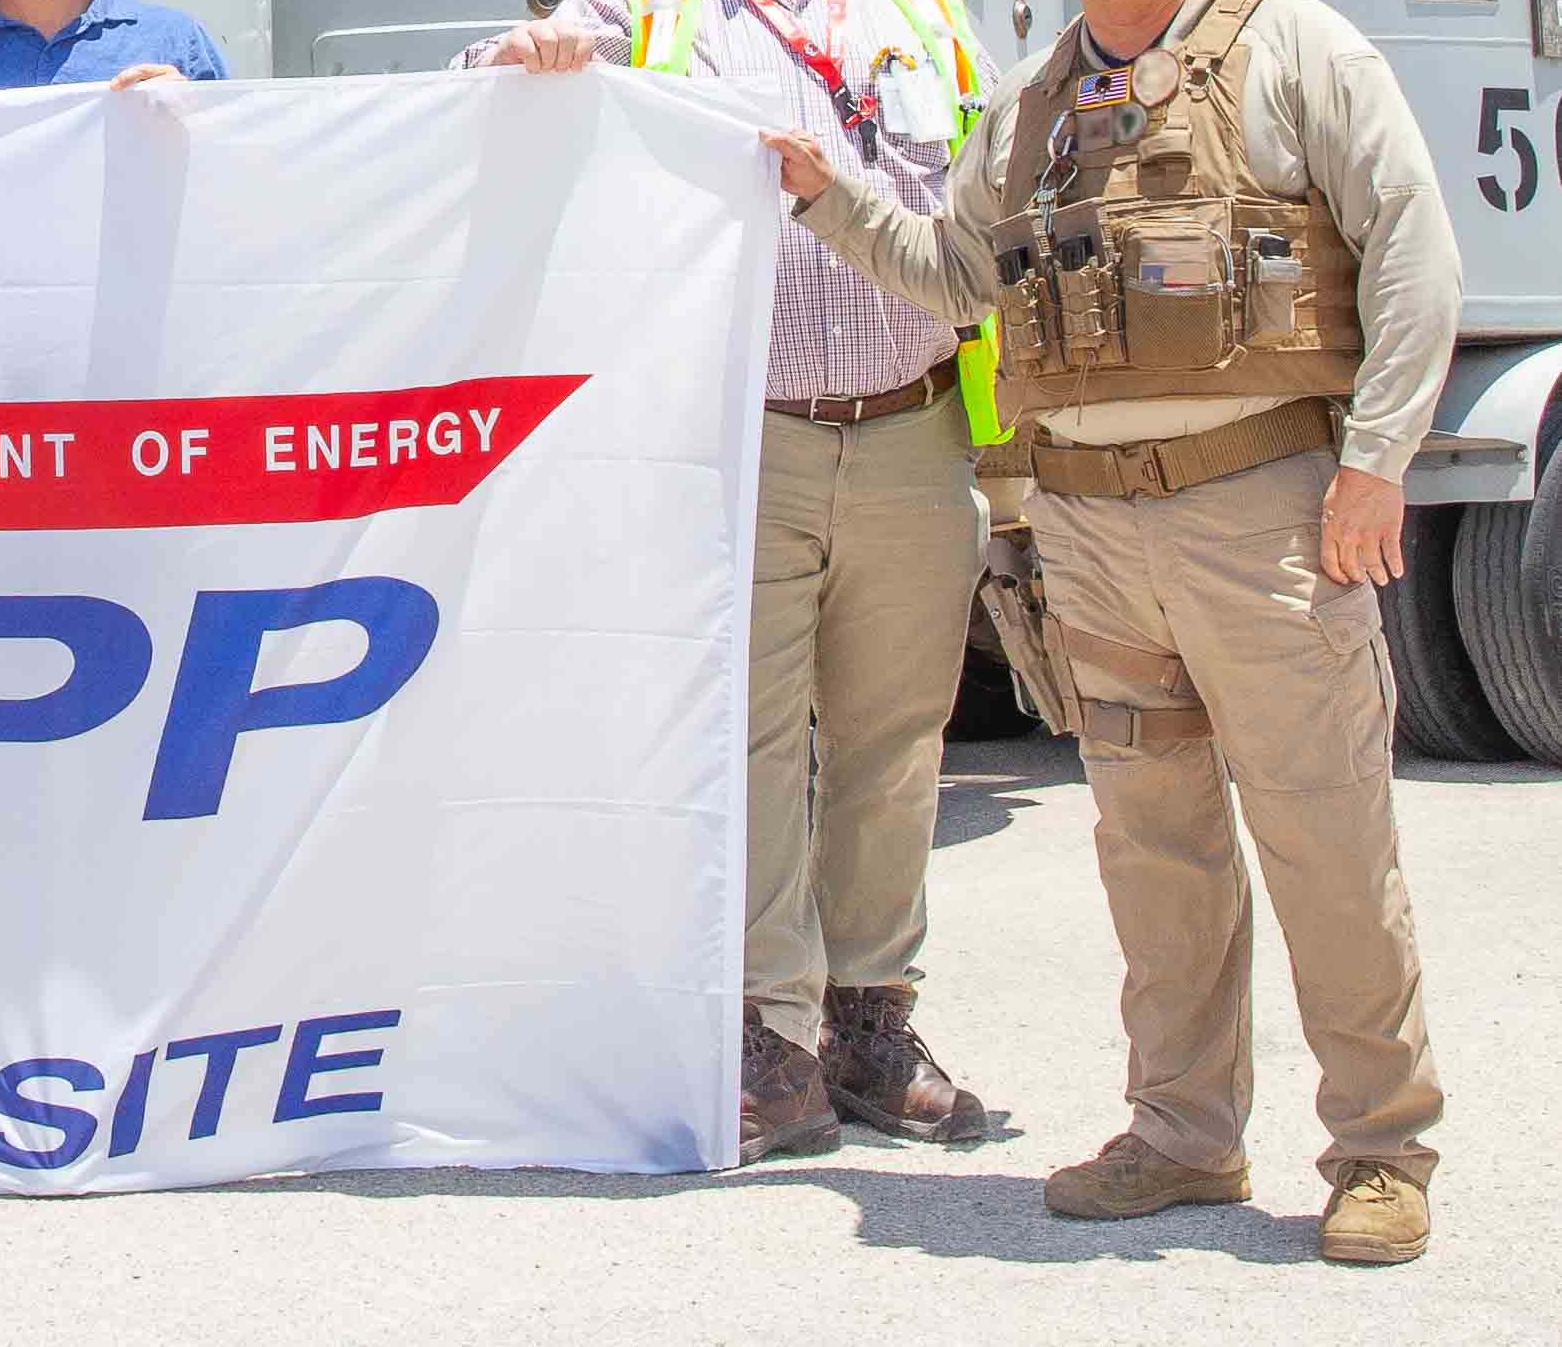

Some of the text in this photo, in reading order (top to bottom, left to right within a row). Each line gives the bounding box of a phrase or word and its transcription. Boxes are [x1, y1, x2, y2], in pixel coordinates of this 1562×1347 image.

[1478, 87, 1562, 212] 5
[131, 429, 209, 477] OF
[266, 407, 502, 472] ENERGY
